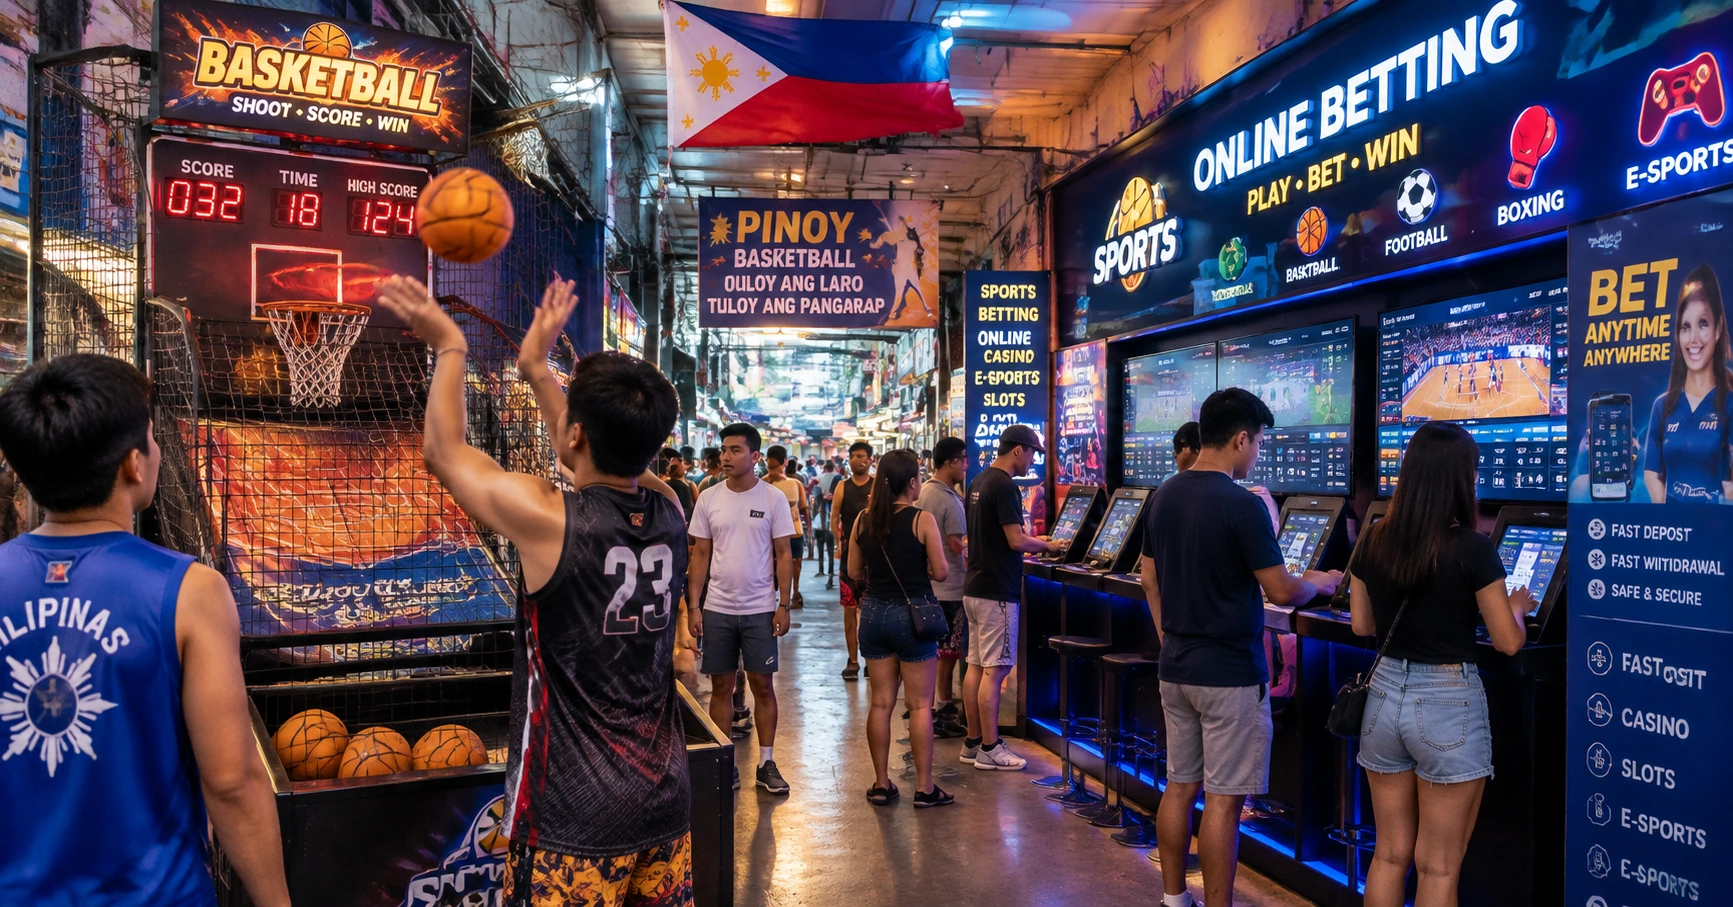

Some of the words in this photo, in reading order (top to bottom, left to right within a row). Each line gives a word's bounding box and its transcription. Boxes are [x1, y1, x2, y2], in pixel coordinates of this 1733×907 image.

[195, 38, 441, 115] BASKETBALL
[1193, 99, 1313, 192] ONLINE
[1319, 0, 1522, 140] BETTING
[231, 96, 292, 118] SHOOT
[307, 105, 363, 127] SCORE
[377, 115, 410, 133] WIN
[181, 159, 234, 178] SCORE
[279, 170, 318, 187] TIME
[1247, 175, 1292, 215] PLAY
[1307, 153, 1347, 193] BET
[1365, 123, 1418, 171] WIN
[1626, 139, 1733, 188] E-SPORTS
[167, 180, 242, 220] 032
[347, 178, 376, 194] HIGH
[379, 182, 418, 198] SCORE
[289, 194, 319, 227] 18
[363, 201, 415, 235] 124
[1497, 189, 1565, 226] BOXING
[737, 210, 855, 244] PINOY
[1385, 225, 1447, 255] FOOTBALL
[734, 248, 856, 268] BASKETBALL
[1093, 217, 1178, 285] SPORTS
[780, 275, 815, 292] ANG
[820, 275, 863, 292] LARO
[981, 284, 1036, 299] SPORTS
[1588, 258, 1678, 316] BET
[707, 297, 758, 314] TULOY
[762, 297, 796, 314] ANG
[800, 298, 885, 314] PANGARAP
[978, 307, 1039, 321] BETTING
[977, 330, 1031, 346] ONLINE
[1584, 314, 1671, 344] ANYTIME
[984, 349, 1034, 363] CASINO
[1583, 343, 1671, 367] ANYWHERE
[983, 393, 1025, 407] SLOTS
[1612, 524, 1640, 538] FAST
[1644, 525, 1692, 541] DEPOST
[1612, 554, 1640, 568] FAST
[603, 543, 674, 635] 23
[1612, 584, 1640, 599] SAFE
[1643, 587, 1652, 600] &
[1655, 588, 1702, 606] SECURE
[1621, 707, 1690, 740] CASINO
[1621, 758, 1675, 790] SLOTS
[1621, 807, 1706, 849] E-SPORTS
[1621, 858, 1699, 901] E-SPORTS
